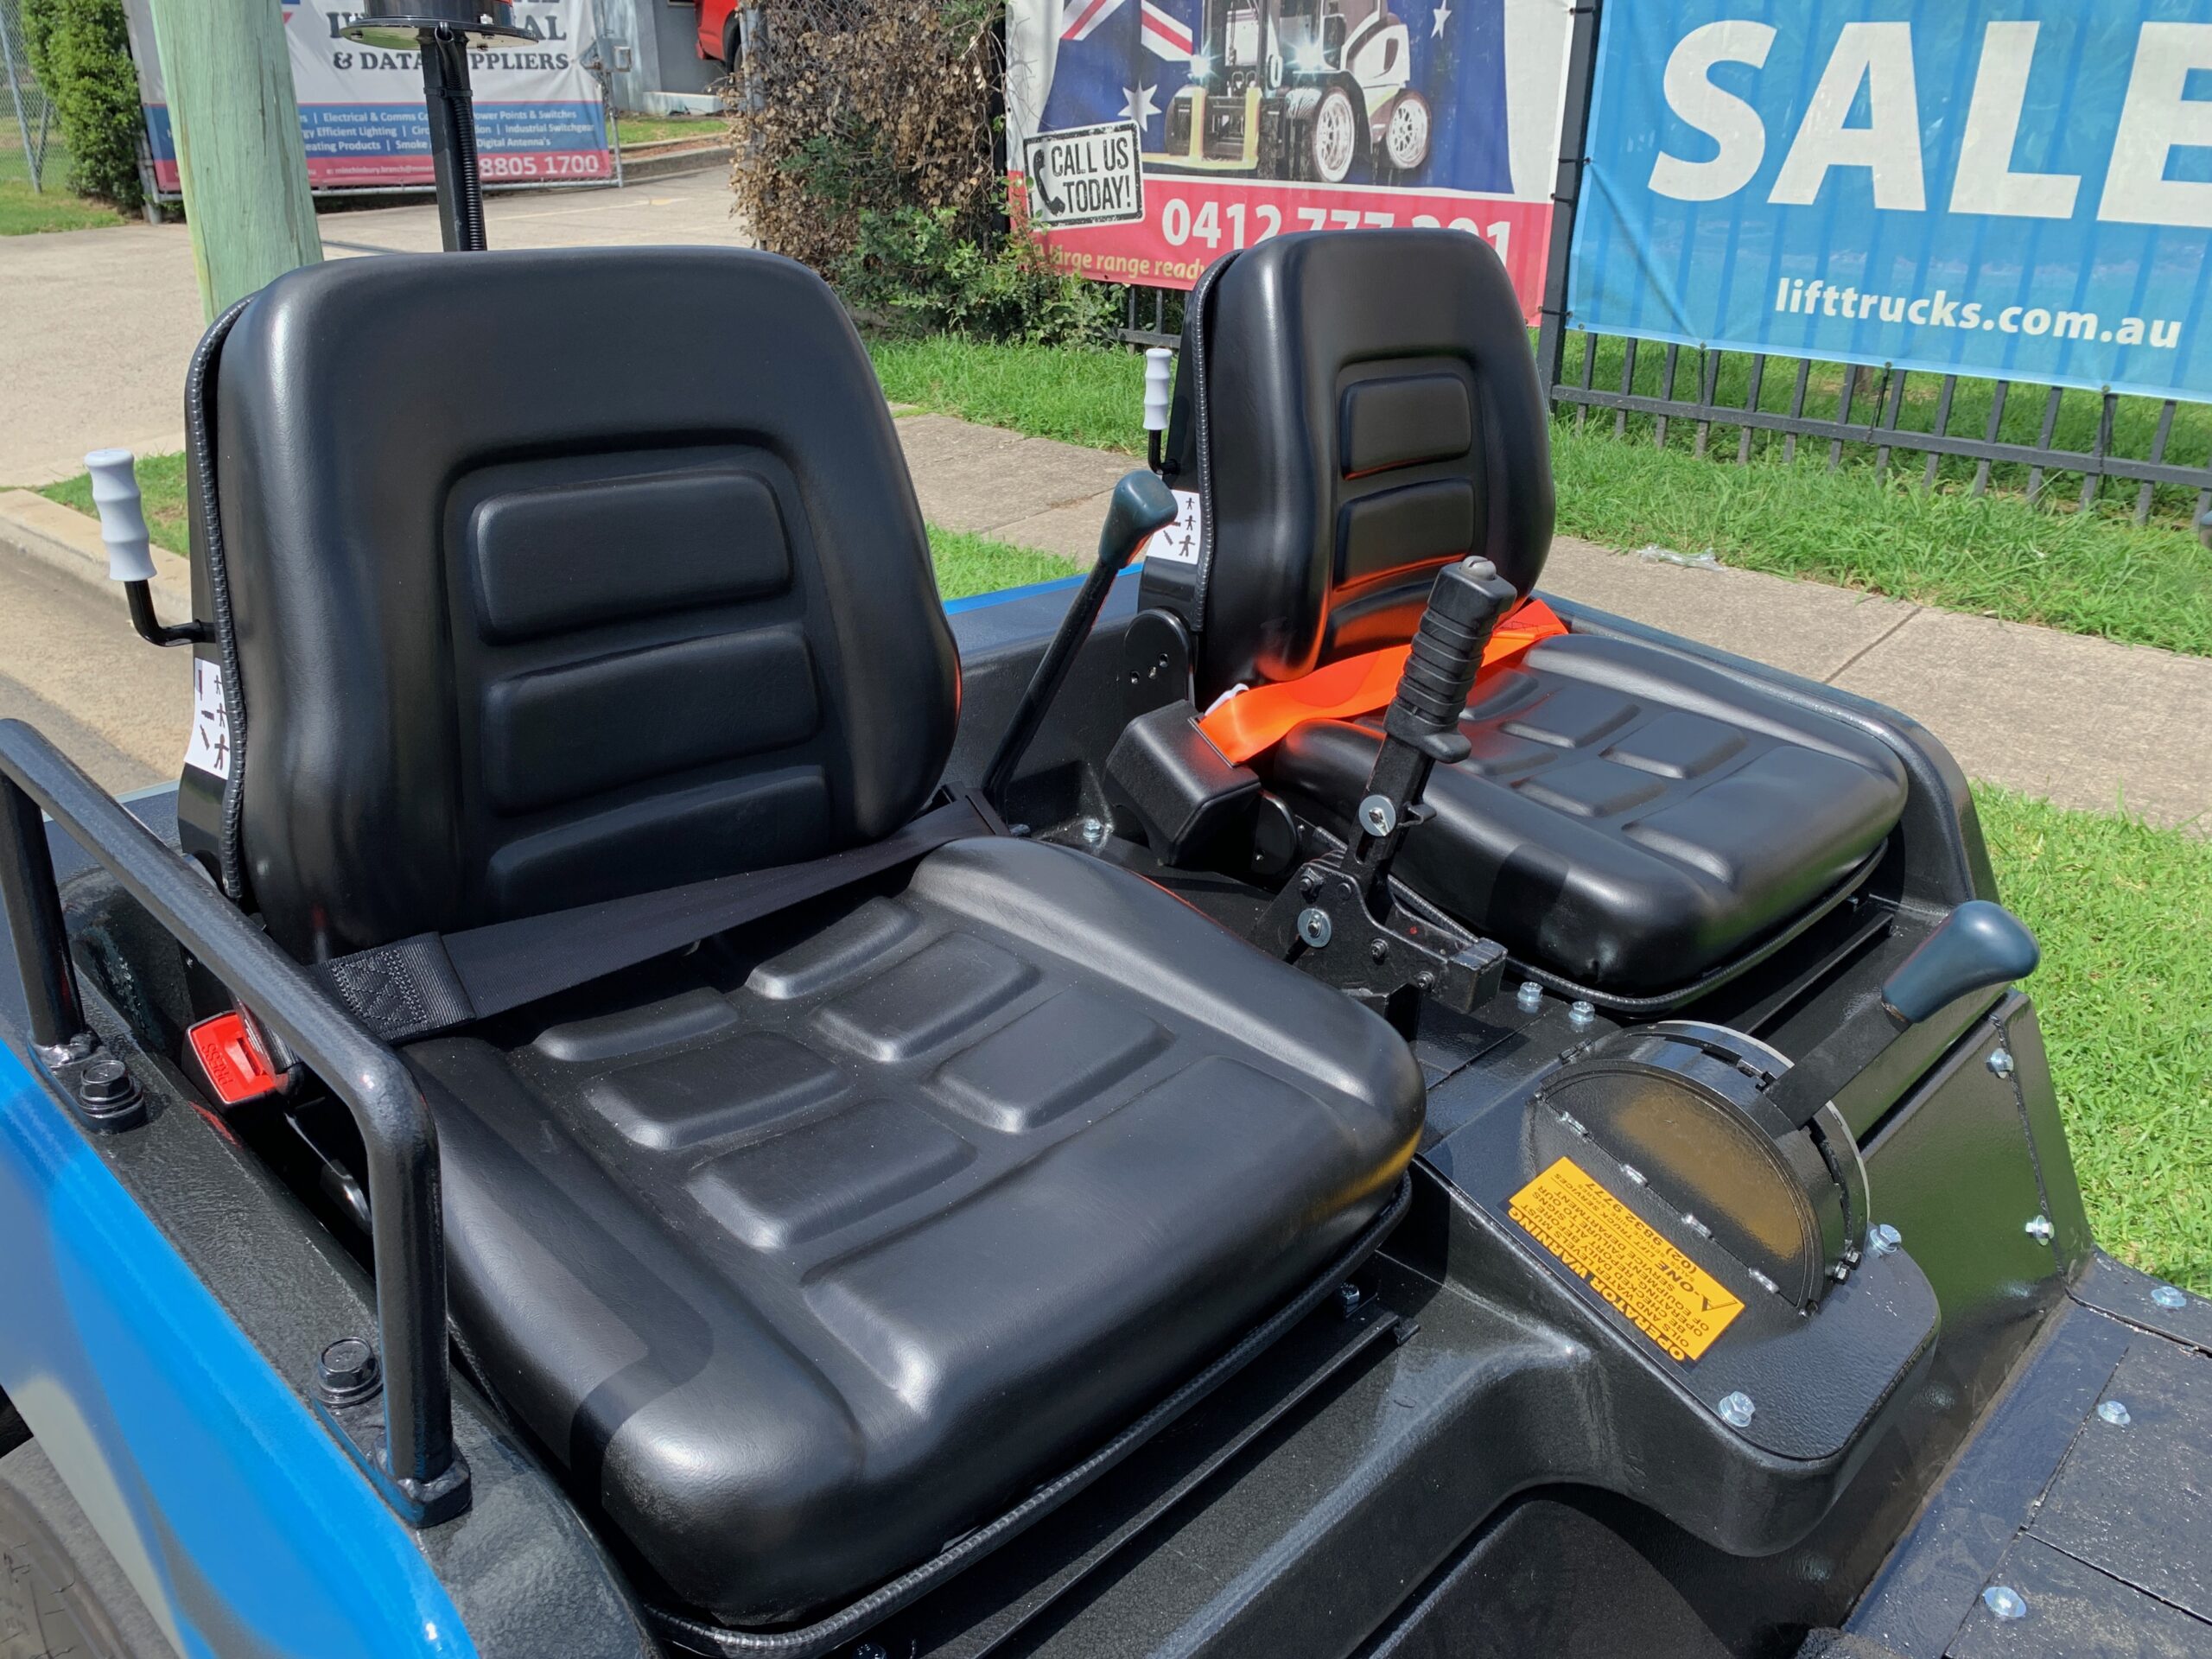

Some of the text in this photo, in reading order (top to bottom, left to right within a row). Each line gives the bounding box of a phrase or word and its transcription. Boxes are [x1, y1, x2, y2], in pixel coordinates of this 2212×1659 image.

[334, 52, 353, 69] &
[467, 53, 569, 70] PPLIERS
[316, 127, 358, 137] Efficient
[359, 127, 397, 138] Lighting
[323, 112, 368, 123] Electrical
[370, 112, 378, 122] &
[380, 112, 416, 122] Comms
[499, 111, 527, 120] Points
[538, 110, 577, 119] Switches
[505, 123, 594, 134] Industrial Switchgear
[1648, 20, 2212, 228] SALE
[305, 141, 381, 152] eating Products
[395, 140, 428, 149] Smoke
[476, 137, 551, 149] Digital Antenna's
[1051, 137, 1129, 177] CALL US
[479, 154, 599, 177] 8805 1700
[1063, 175, 1131, 214] TODAY!
[1161, 197, 1282, 251] 0412
[1096, 255, 1150, 279] range
[1776, 277, 2183, 349] lifttrucks.com.au
[1554, 1191, 1675, 1291] SERVICE DEPARTMENT
[1554, 1173, 1738, 1312] A-ONE LIFT TRUCK SERVICES
[1584, 1182, 1697, 1274] (02) 9832 9777
[1520, 1204, 1689, 1347] OILS AND WATER LEVELS MUST
[1532, 1191, 1702, 1337] OPERATING. REPORT ALL SIGNS
[1535, 1205, 1686, 1333] BE CHECKED DAILY BEFORE
[1537, 1185, 1709, 1332] OF EQUIPMENT FAILURE TO OUR
[1508, 1206, 1684, 1360] OPERATOR WARNING
